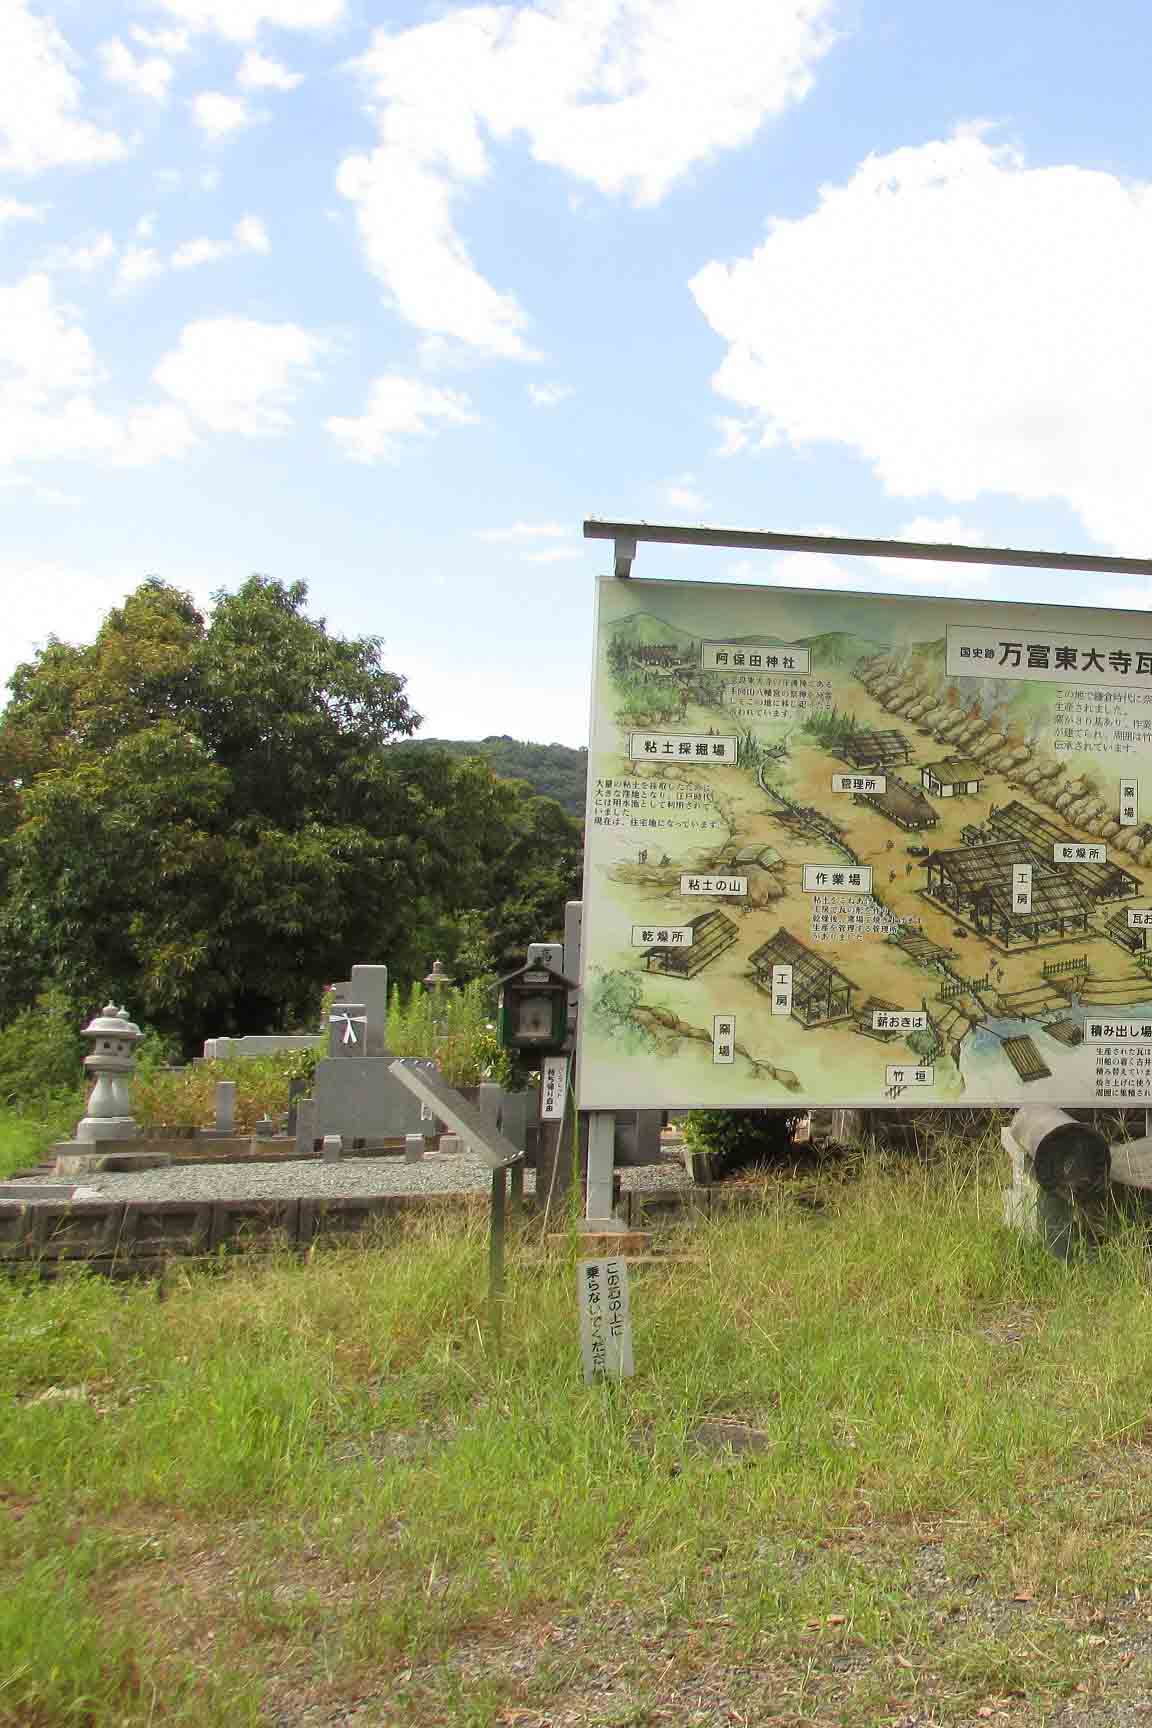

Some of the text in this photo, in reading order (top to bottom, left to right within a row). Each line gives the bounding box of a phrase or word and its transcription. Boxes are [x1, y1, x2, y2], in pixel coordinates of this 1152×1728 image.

[959, 645, 995, 660] 国史跡
[715, 652, 797, 669] 阿保田神社
[643, 739, 730, 757] 粘土採掘場
[840, 777, 877, 790] 管理所
[1123, 786, 1135, 818] 窯場
[1062, 847, 1100, 860] 乾燥所
[687, 880, 741, 892] 粘土の山
[815, 872, 862, 886] 作業場
[1016, 873, 1028, 905] 工房
[641, 930, 685, 943] 乾燥所
[776, 973, 788, 1008] 工房
[877, 1016, 923, 1028] 薪おきば
[1090, 1024, 1152, 1038] 積み出し場
[718, 1023, 731, 1057] 窯場
[892, 1069, 926, 1083] 竹垣
[606, 1262, 625, 1337] この石の上に
